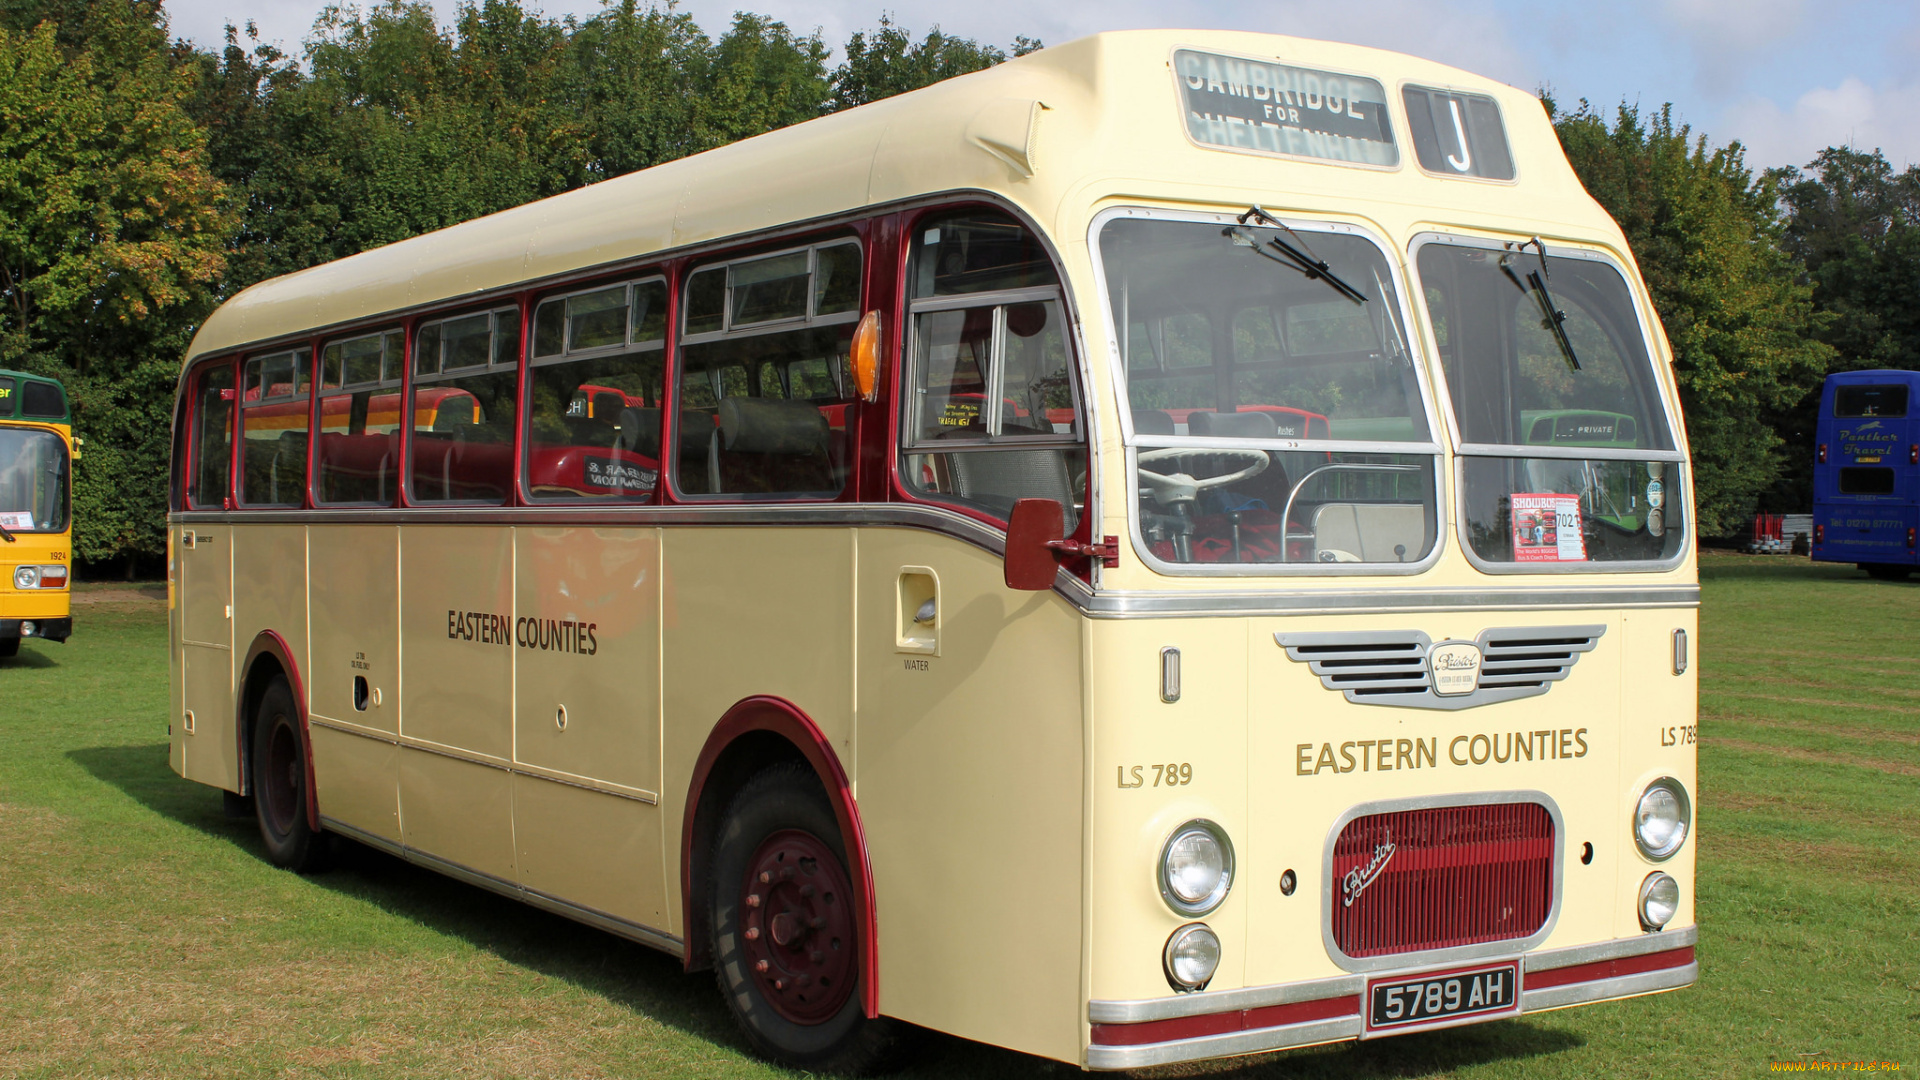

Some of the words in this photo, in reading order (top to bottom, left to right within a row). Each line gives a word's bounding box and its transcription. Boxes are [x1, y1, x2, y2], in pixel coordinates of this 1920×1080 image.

[1183, 54, 1365, 120] CAMBRIDGE
[1263, 104, 1299, 124] FOR
[1448, 99, 1470, 172] J
[1577, 426, 1613, 434] PRIVATE
[1839, 430, 1898, 442] Panther
[1843, 444, 1892, 455] Travel
[1513, 497, 1556, 509] SHOWBUS
[1556, 513, 1579, 528] 7021
[50, 552, 66, 560] 1924
[448, 610, 511, 645] EASTERN
[516, 617, 597, 655] COUNTIES
[904, 659, 929, 671] WATER
[1435, 653, 1477, 671] Bristol
[1661, 727, 1676, 746] LS
[1296, 736, 1437, 776] EASTERN
[1448, 728, 1588, 767] COUNTIES
[1118, 765, 1144, 788] LS
[1151, 763, 1193, 787] 789
[1344, 829, 1396, 907] Bristol
[1385, 980, 1462, 1019] 5789
[1468, 973, 1503, 1008] AH
